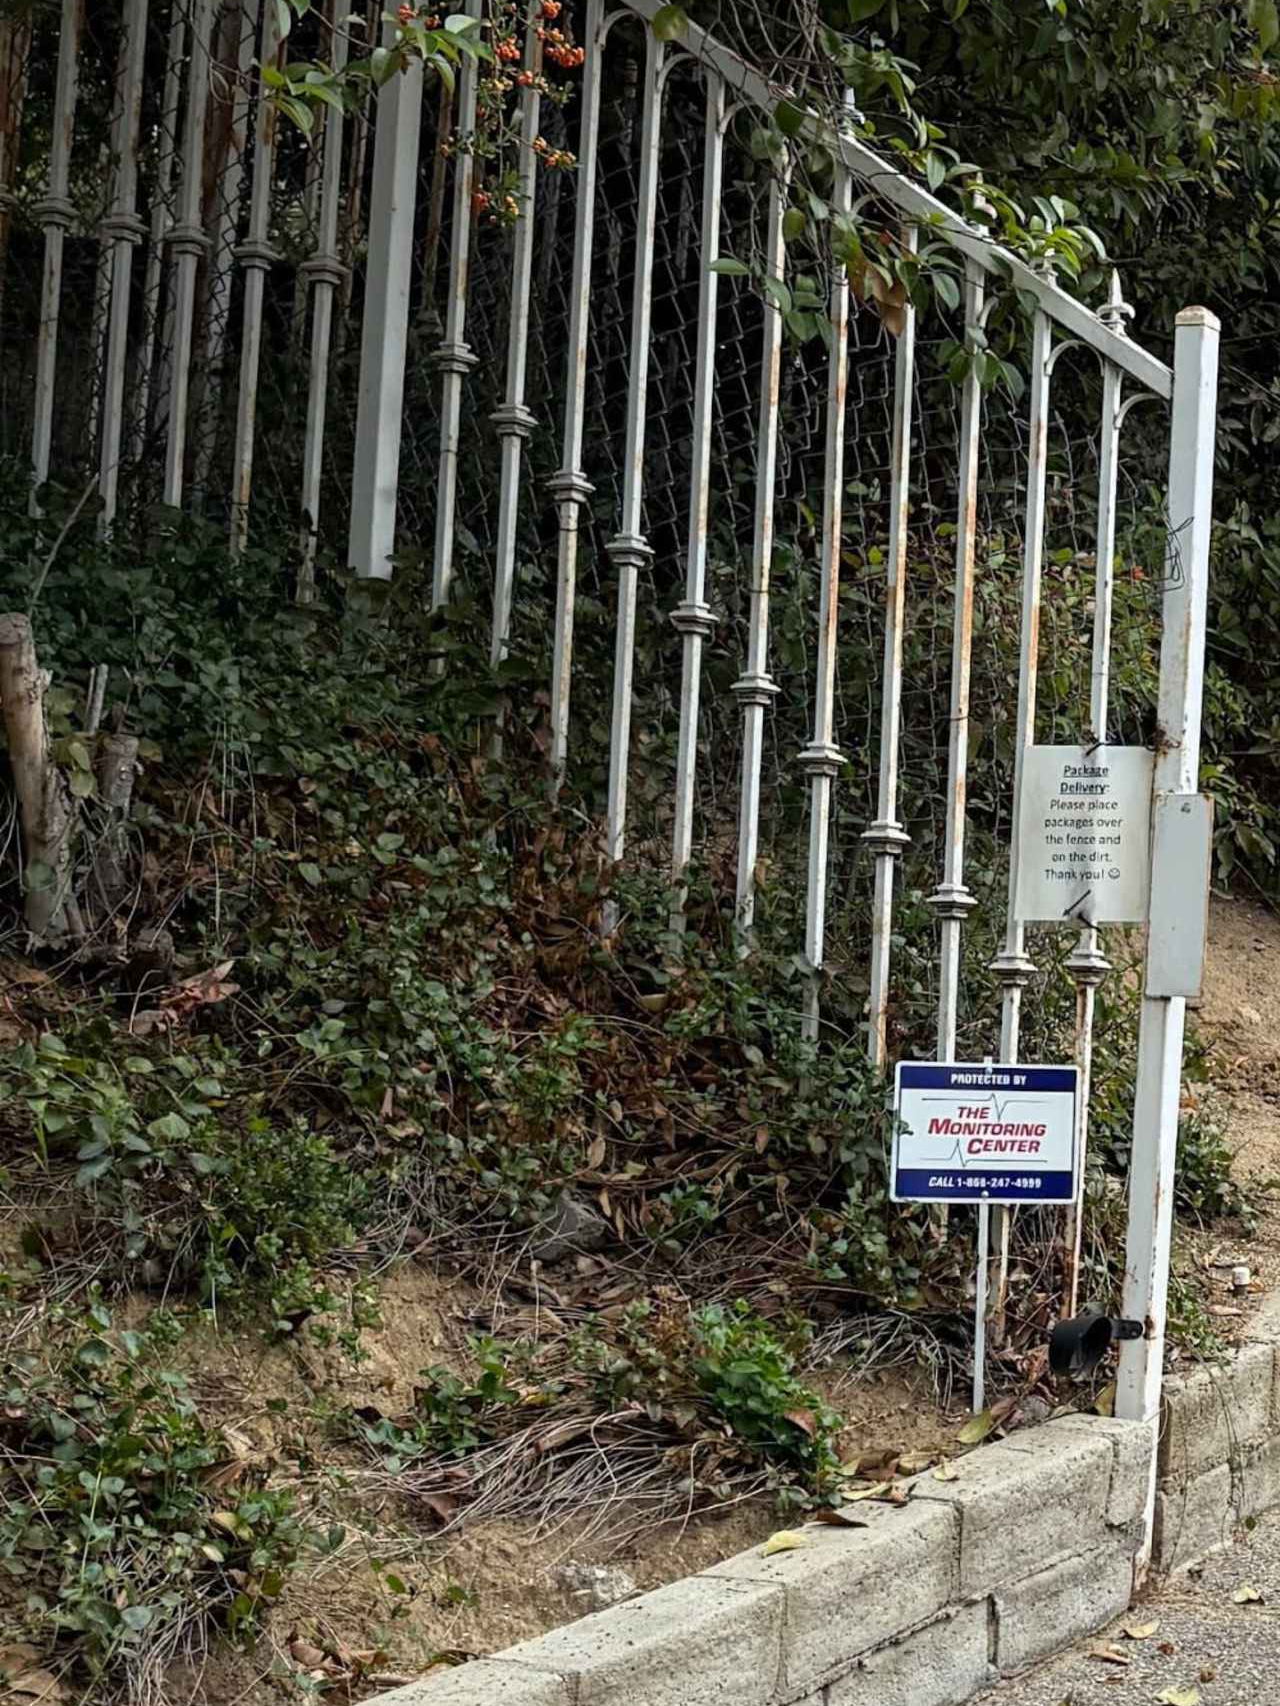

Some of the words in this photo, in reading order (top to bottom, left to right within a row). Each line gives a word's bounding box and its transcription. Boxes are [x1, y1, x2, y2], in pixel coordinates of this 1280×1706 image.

[1063, 765, 1109, 778] Package
[1060, 782, 1111, 795] Delivery:
[1050, 799, 1085, 810] Please
[1088, 800, 1118, 812] place
[1044, 817, 1094, 829] packages
[1096, 818, 1123, 827] over
[1045, 834, 1063, 845] the
[1066, 833, 1096, 845] fence
[1099, 834, 1121, 845] and
[1052, 853, 1066, 862] on
[1069, 852, 1087, 862] the
[1089, 852, 1112, 862] dirt.
[1045, 869, 1078, 880] Thank
[1080, 869, 1105, 881] you!
[951, 1074, 1011, 1085] PROTECTED
[1013, 1075, 1027, 1085] BY
[957, 1106, 991, 1119] THE
[928, 1118, 1047, 1137] MONITORING
[967, 1138, 1041, 1154] CENTER
[928, 1176, 954, 1187] CALL
